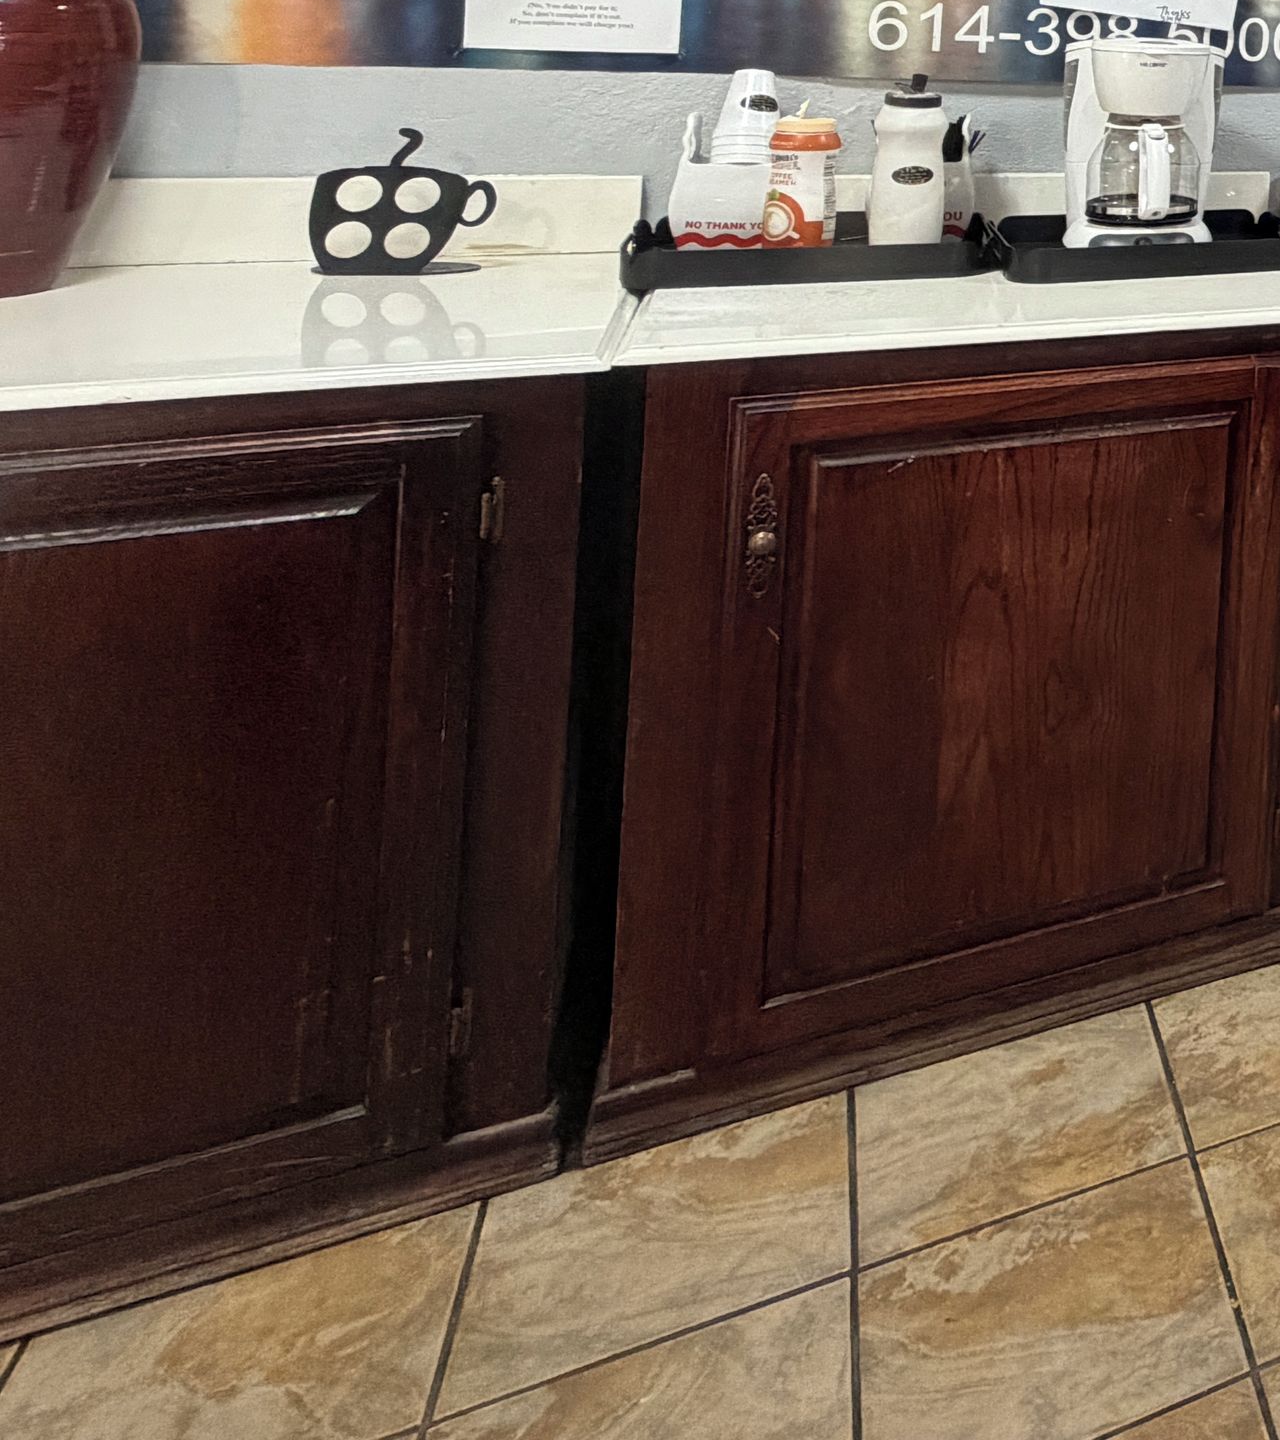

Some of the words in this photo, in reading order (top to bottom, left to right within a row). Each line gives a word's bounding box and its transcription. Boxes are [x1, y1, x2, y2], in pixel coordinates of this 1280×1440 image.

[944, 211, 963, 221] OU
[685, 221, 702, 229] NO
[704, 222, 747, 230] THANK
[750, 222, 764, 230] YO
